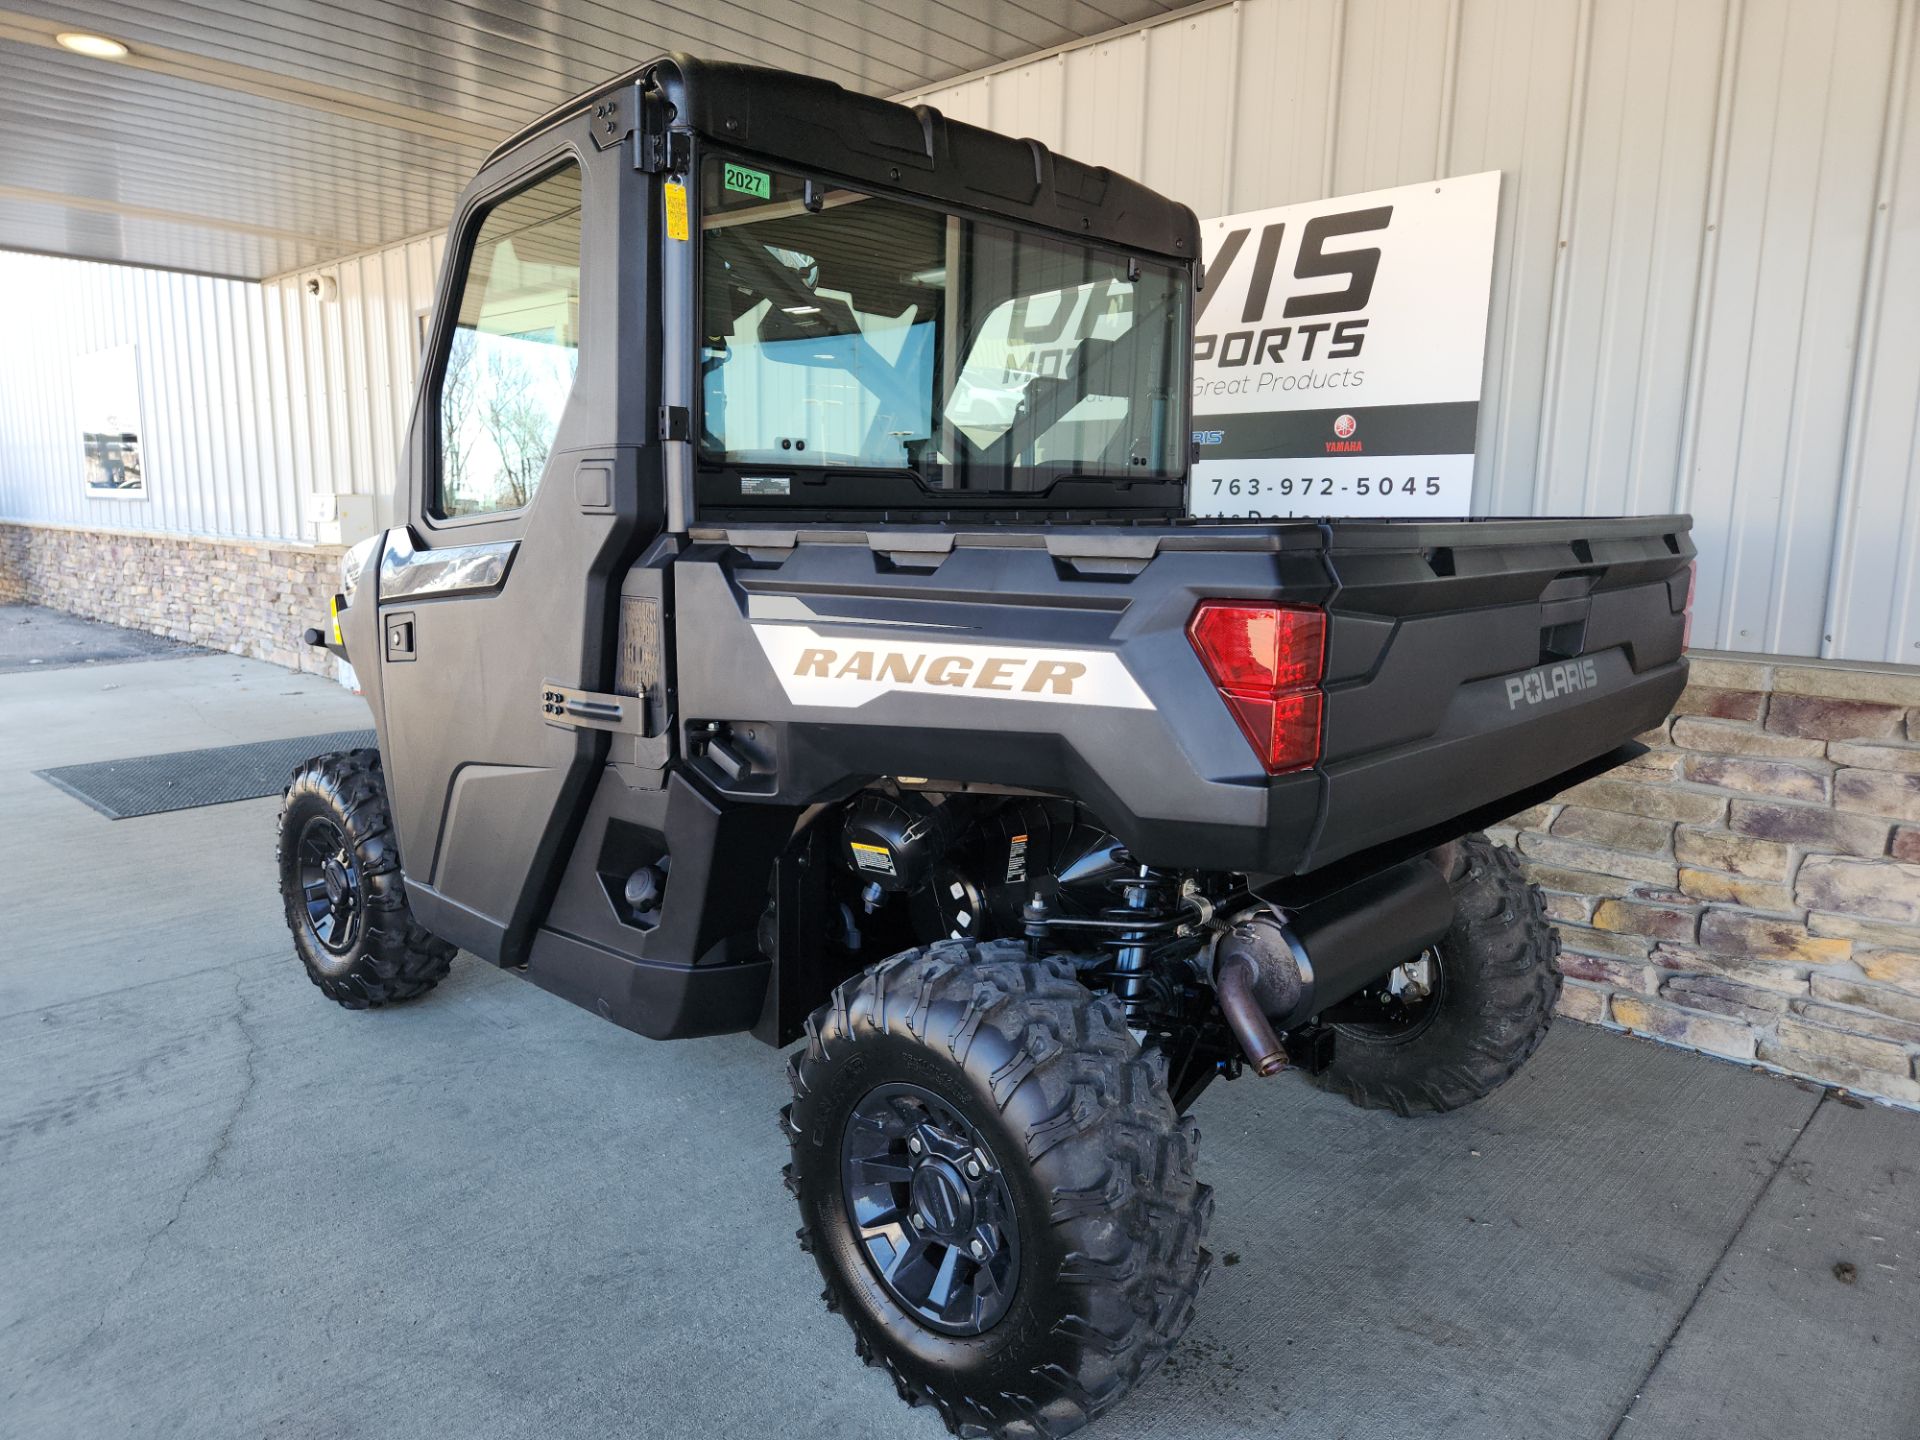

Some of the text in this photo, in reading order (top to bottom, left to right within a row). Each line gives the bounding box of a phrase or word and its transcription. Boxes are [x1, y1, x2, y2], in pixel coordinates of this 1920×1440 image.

[727, 169, 762, 192] 2027
[1193, 368, 1366, 397] Great Products
[1325, 441, 1362, 453] YAMAHA
[1212, 476, 1442, 497] 763-972-5045
[794, 648, 1087, 696] RANGER
[1505, 659, 1598, 711] POLARIS
